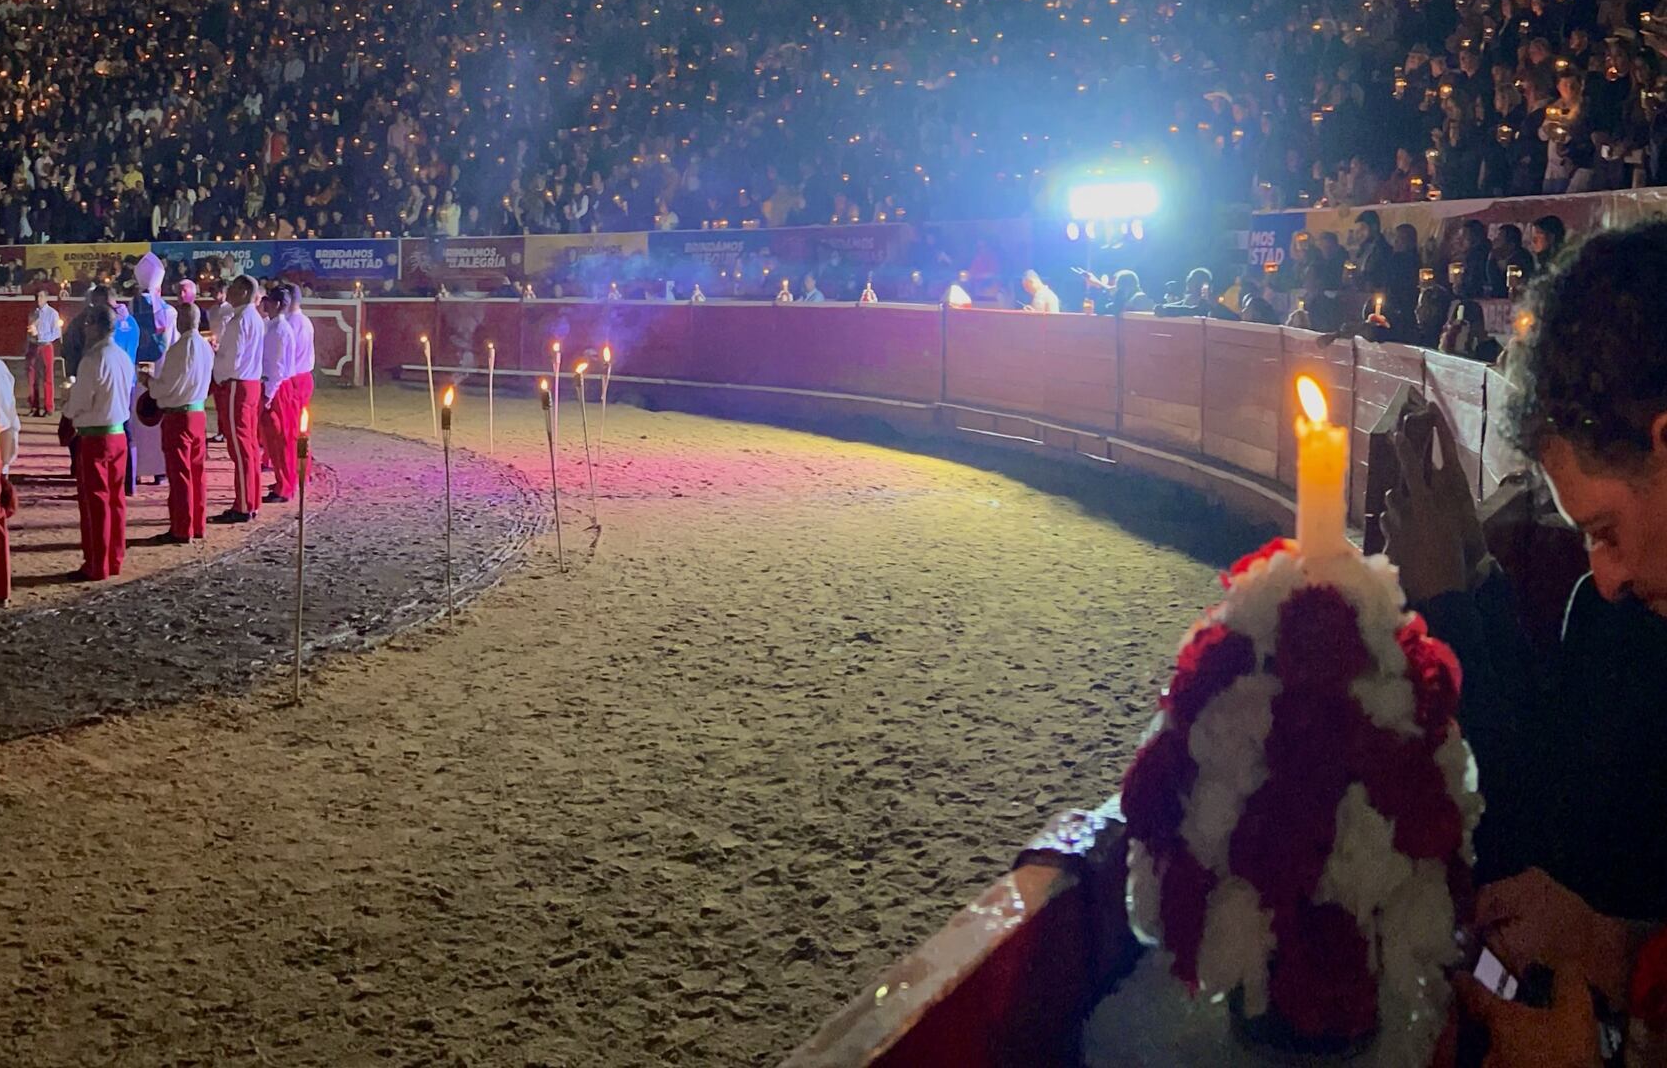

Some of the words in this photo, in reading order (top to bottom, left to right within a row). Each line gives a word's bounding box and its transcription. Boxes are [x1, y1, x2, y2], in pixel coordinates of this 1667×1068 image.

[315, 249, 374, 259] BRINDAMOS
[443, 247, 498, 258] BRINDAMOS
[331, 258, 384, 269] AMISTAD
[457, 254, 506, 269] ALEGRÍA
